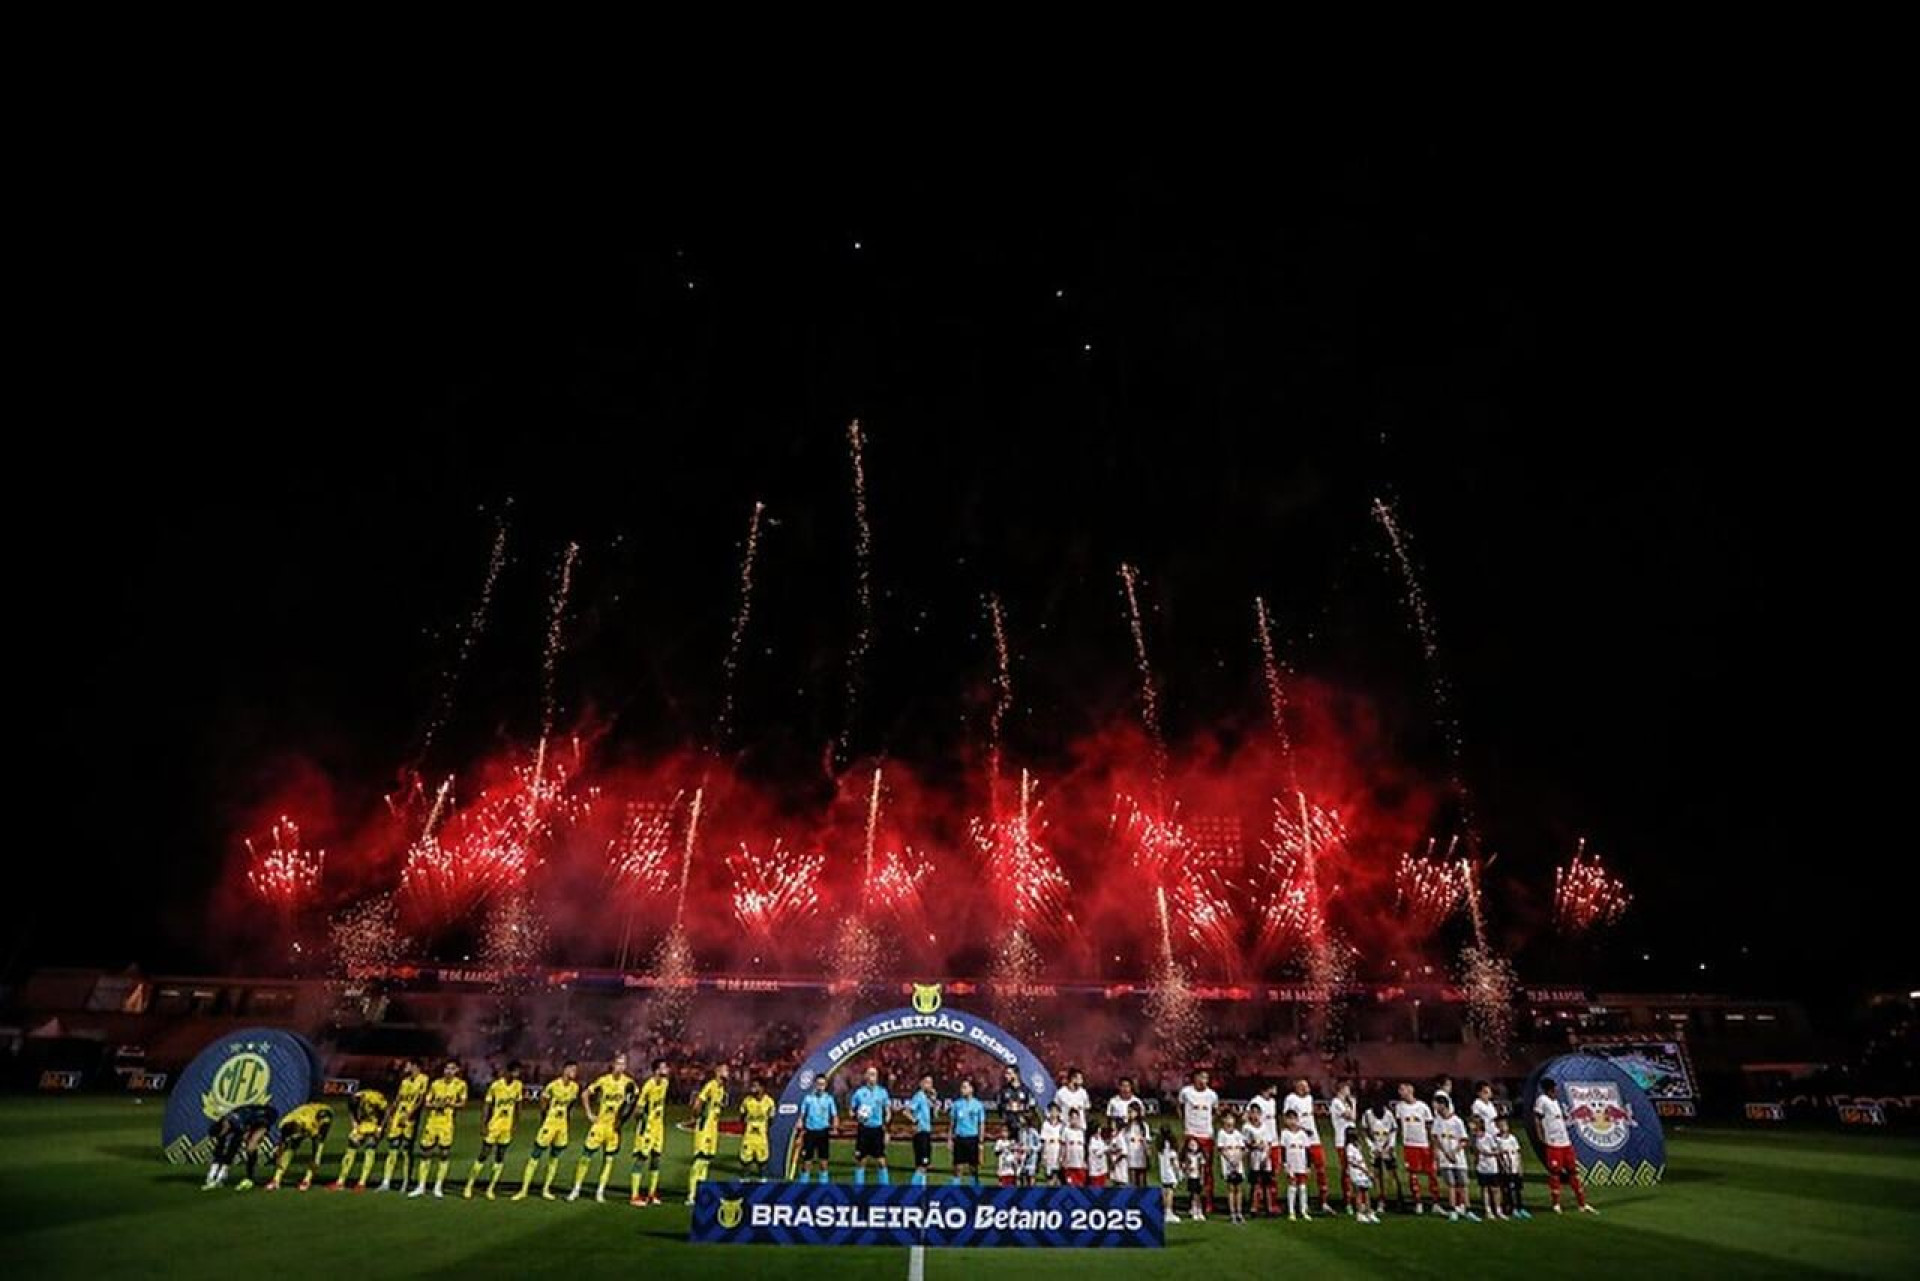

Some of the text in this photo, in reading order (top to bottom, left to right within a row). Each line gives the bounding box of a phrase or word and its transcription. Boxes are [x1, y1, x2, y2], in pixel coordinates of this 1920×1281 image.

[828, 1014, 1017, 1064] BRASILEIRÃO Betano
[752, 1200, 1143, 1231] BRASILEIRÃO Betano 2025
